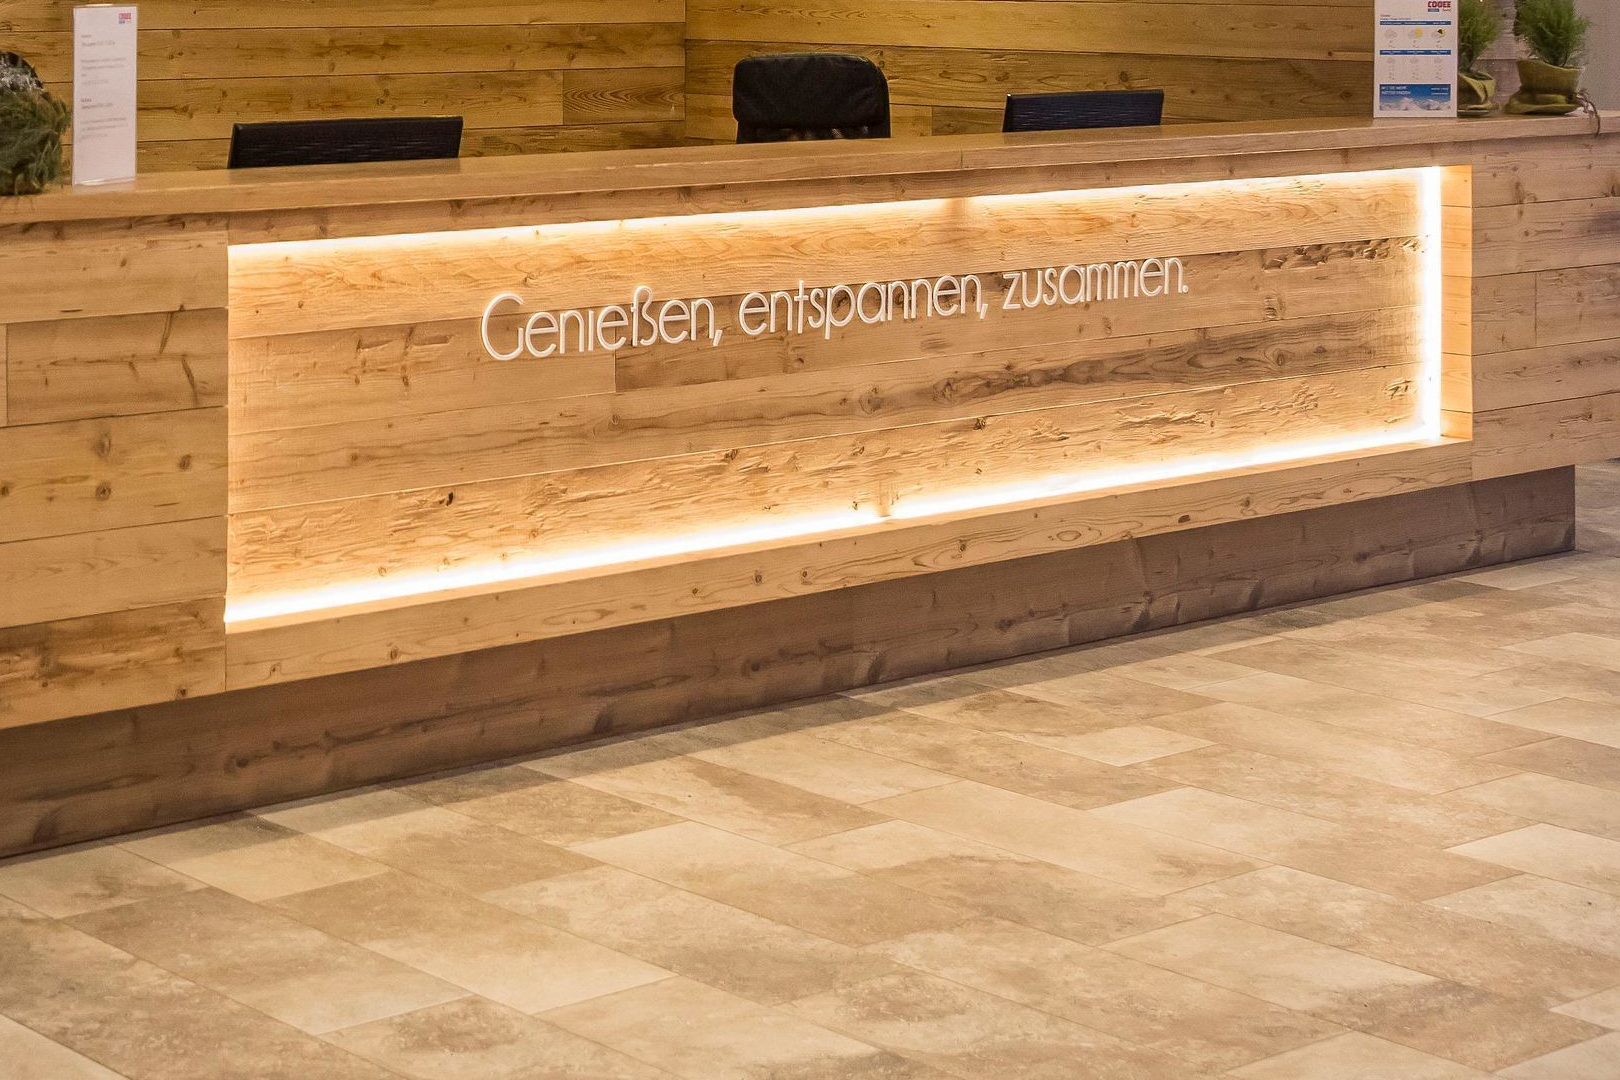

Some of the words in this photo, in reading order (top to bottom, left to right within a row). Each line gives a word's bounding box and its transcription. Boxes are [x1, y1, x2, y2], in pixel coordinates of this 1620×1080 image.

[480, 285, 723, 361] Genießen,
[738, 269, 988, 340] entspannen,
[1000, 256, 1190, 311] zusammen.
